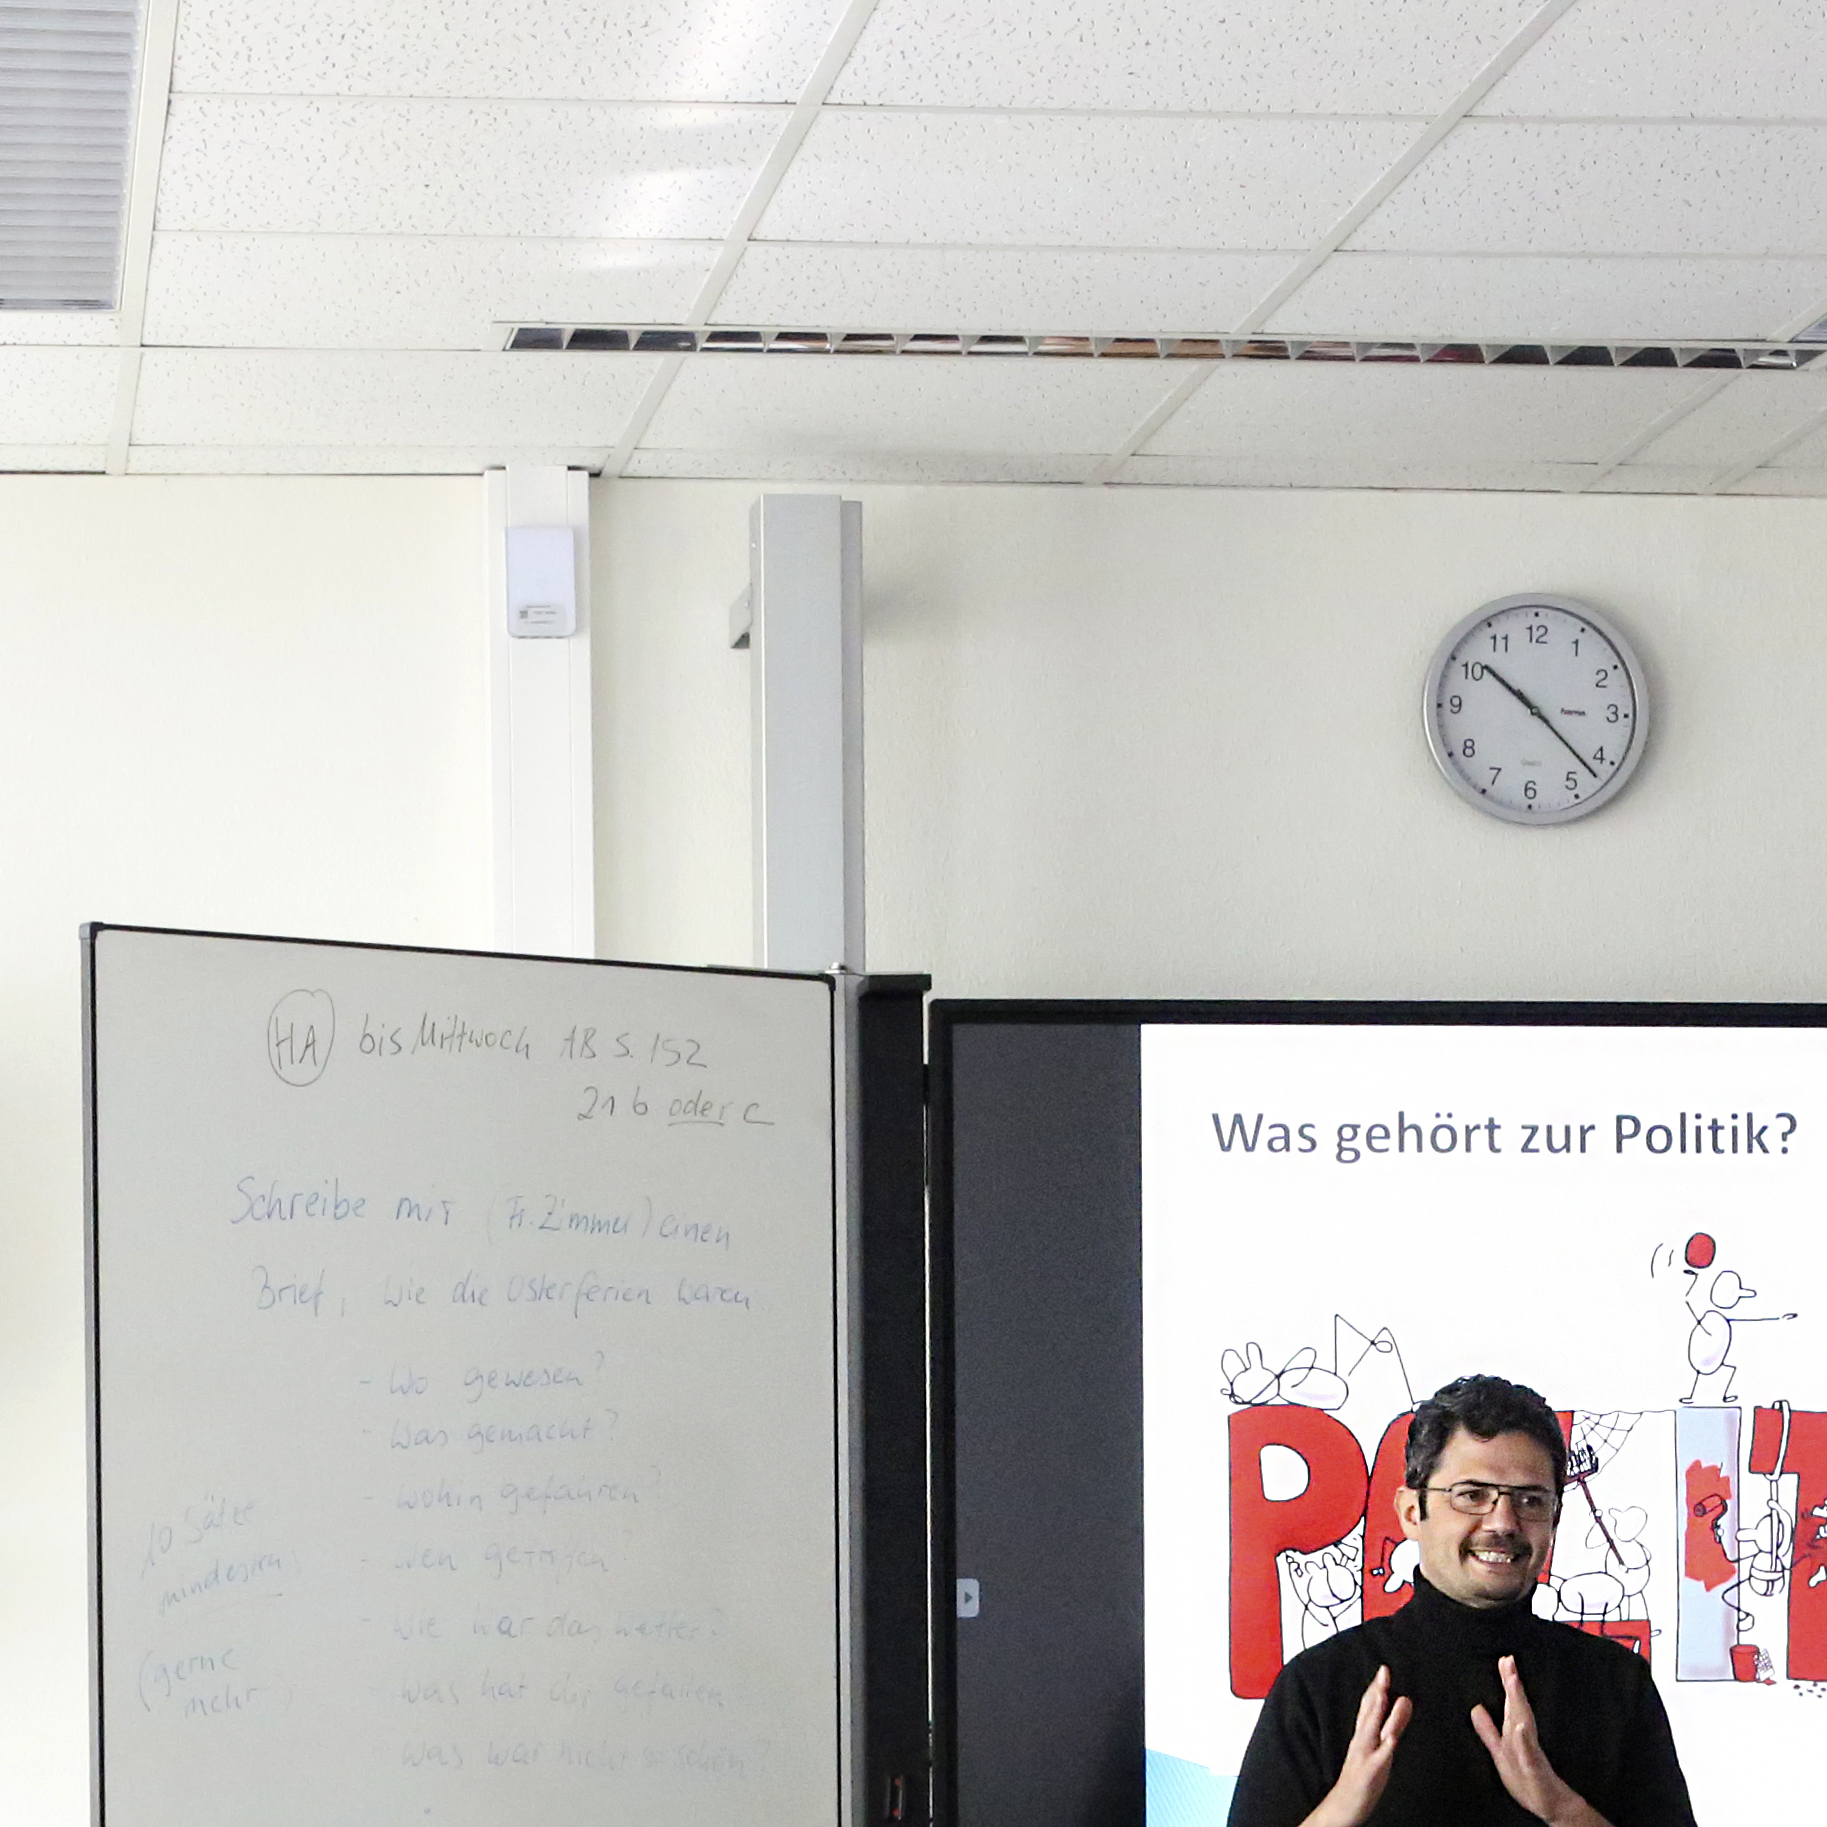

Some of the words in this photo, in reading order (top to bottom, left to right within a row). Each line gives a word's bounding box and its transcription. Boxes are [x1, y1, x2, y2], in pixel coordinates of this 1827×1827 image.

[1526, 624, 1548, 644] 12
[1490, 635, 1509, 653] 11
[1572, 639, 1580, 657] 1
[1462, 661, 1484, 681] 10
[1595, 669, 1608, 688] 2
[1449, 695, 1462, 713] 9
[1606, 704, 1619, 723] 3
[1462, 738, 1475, 757] 8
[1592, 746, 1606, 764] 4
[1489, 767, 1502, 785] 7
[1565, 772, 1578, 790] 5
[1524, 780, 1537, 799] 6
[275, 1017, 319, 1069] HA
[358, 1013, 405, 1058] bis
[411, 1011, 532, 1061] Mittwoch
[649, 1032, 709, 1069] 152
[668, 1090, 729, 1124] oder
[1213, 1111, 1317, 1156] Was
[1335, 1109, 1503, 1164] gehört
[1520, 1121, 1597, 1156] zur
[1615, 1111, 1798, 1158] Politik?
[230, 1174, 367, 1226] Schreibe
[395, 1195, 454, 1227] mit
[659, 1214, 731, 1251] einen
[451, 1268, 490, 1307] die
[507, 1273, 653, 1320] Osterferien
